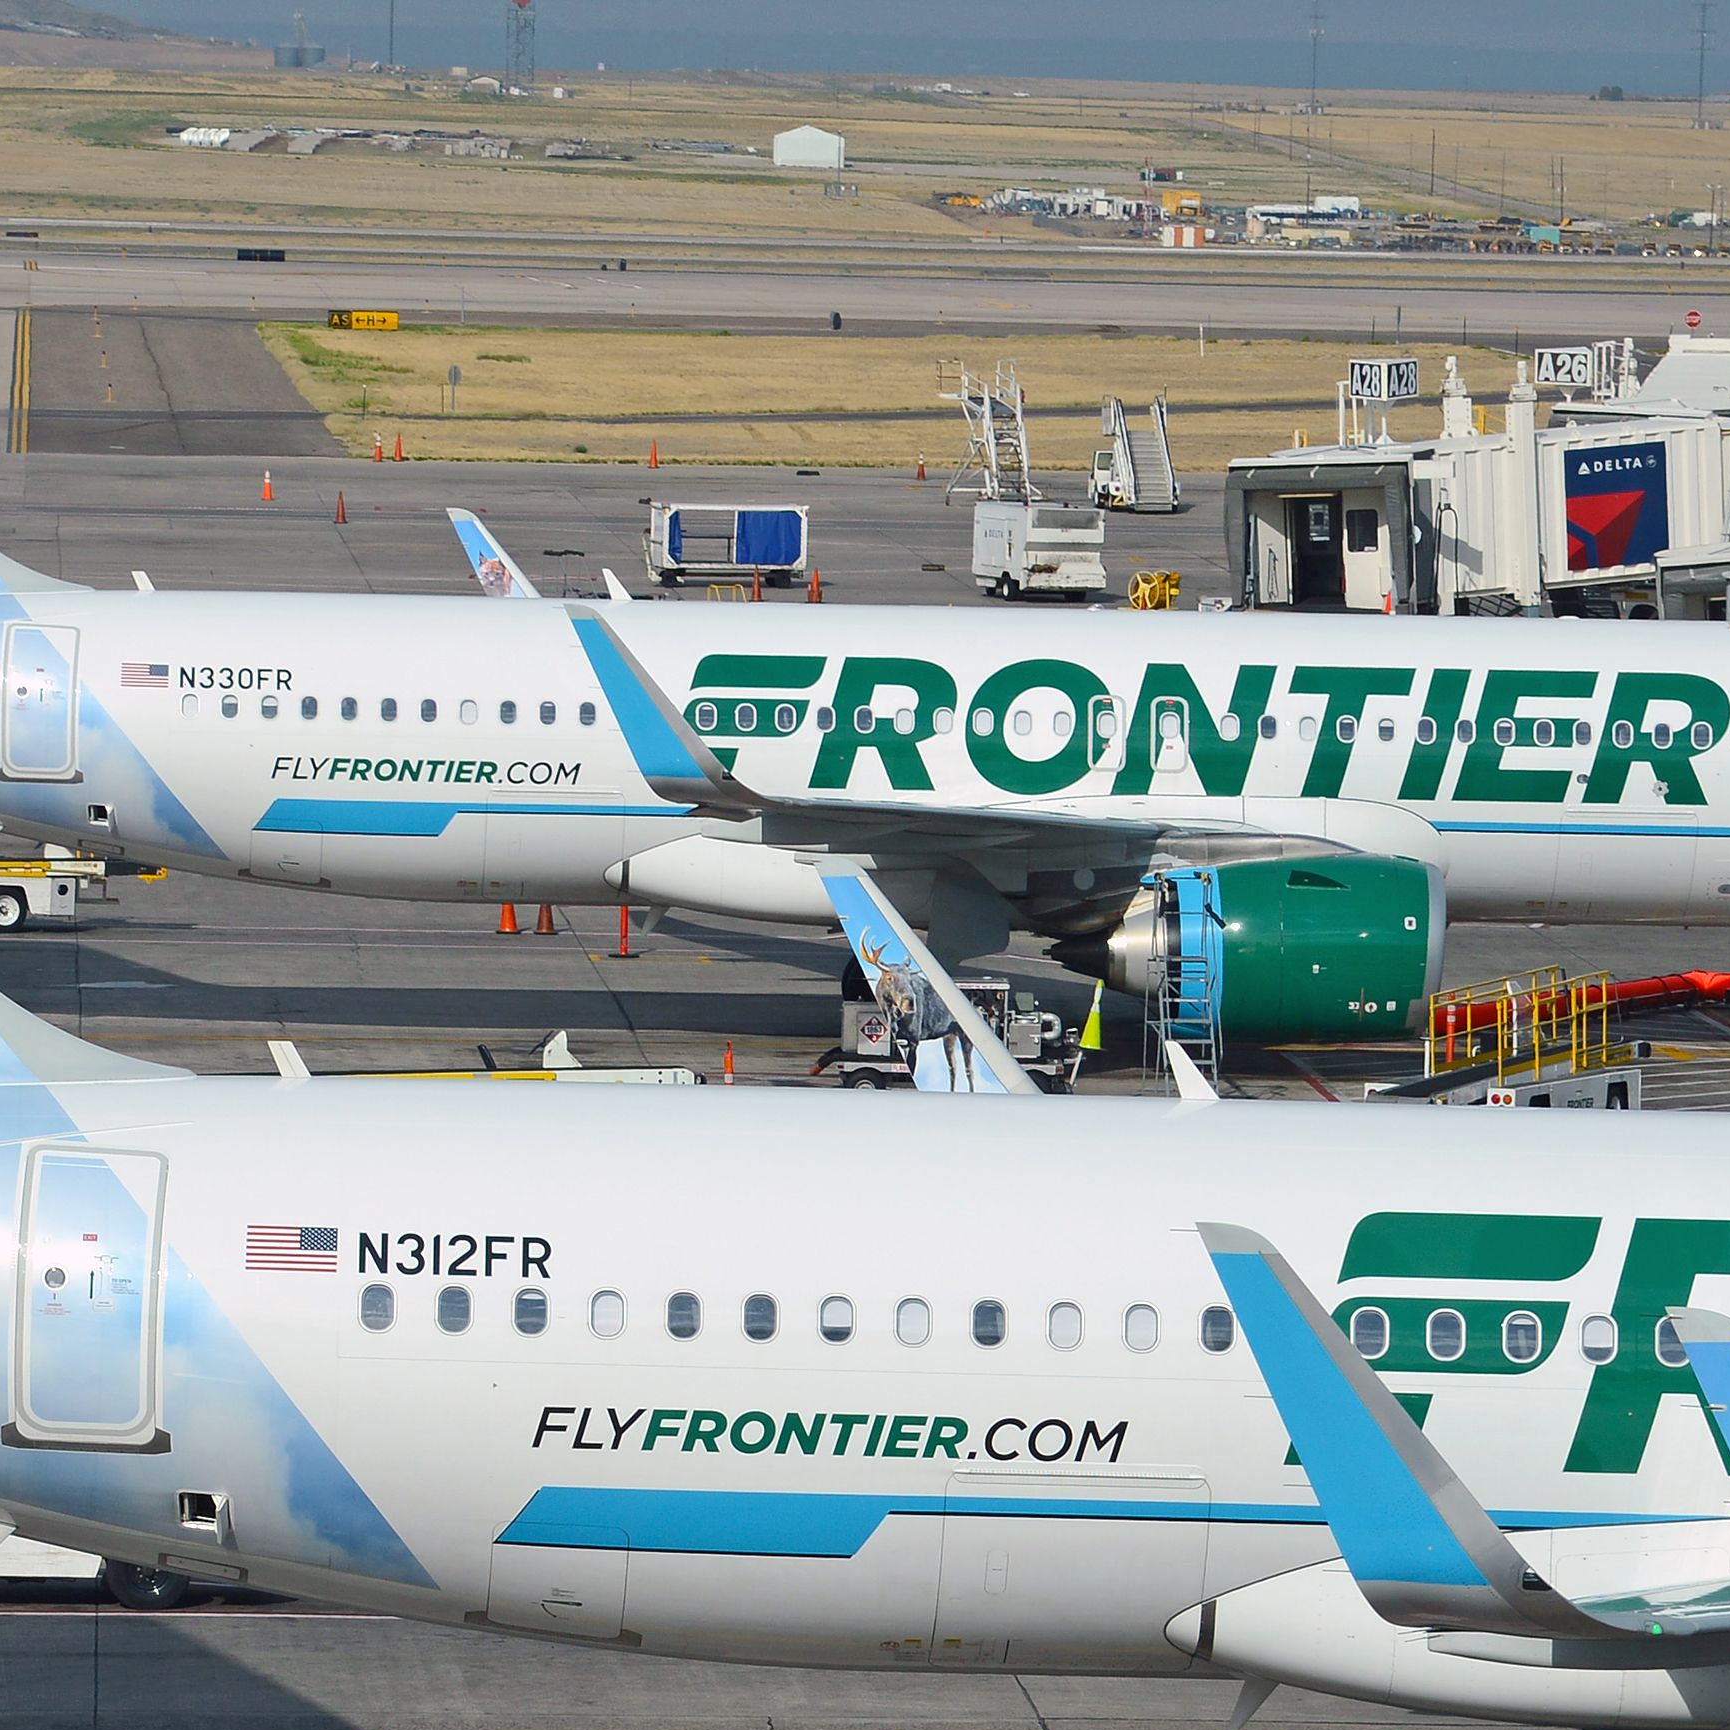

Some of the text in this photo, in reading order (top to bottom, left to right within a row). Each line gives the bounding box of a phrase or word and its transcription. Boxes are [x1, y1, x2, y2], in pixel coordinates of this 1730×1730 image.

[1352, 364, 1380, 397] A28
[1389, 362, 1417, 396] A28
[1539, 353, 1588, 382] A26
[1593, 457, 1643, 473] DELTA
[179, 667, 292, 691] N330FR
[687, 654, 1730, 807] FRONTIER
[271, 757, 581, 785] FLYFRONTIER.COM
[358, 1232, 553, 1279] N312FR
[532, 1406, 1129, 1463] FLYFRONTIER.COM
